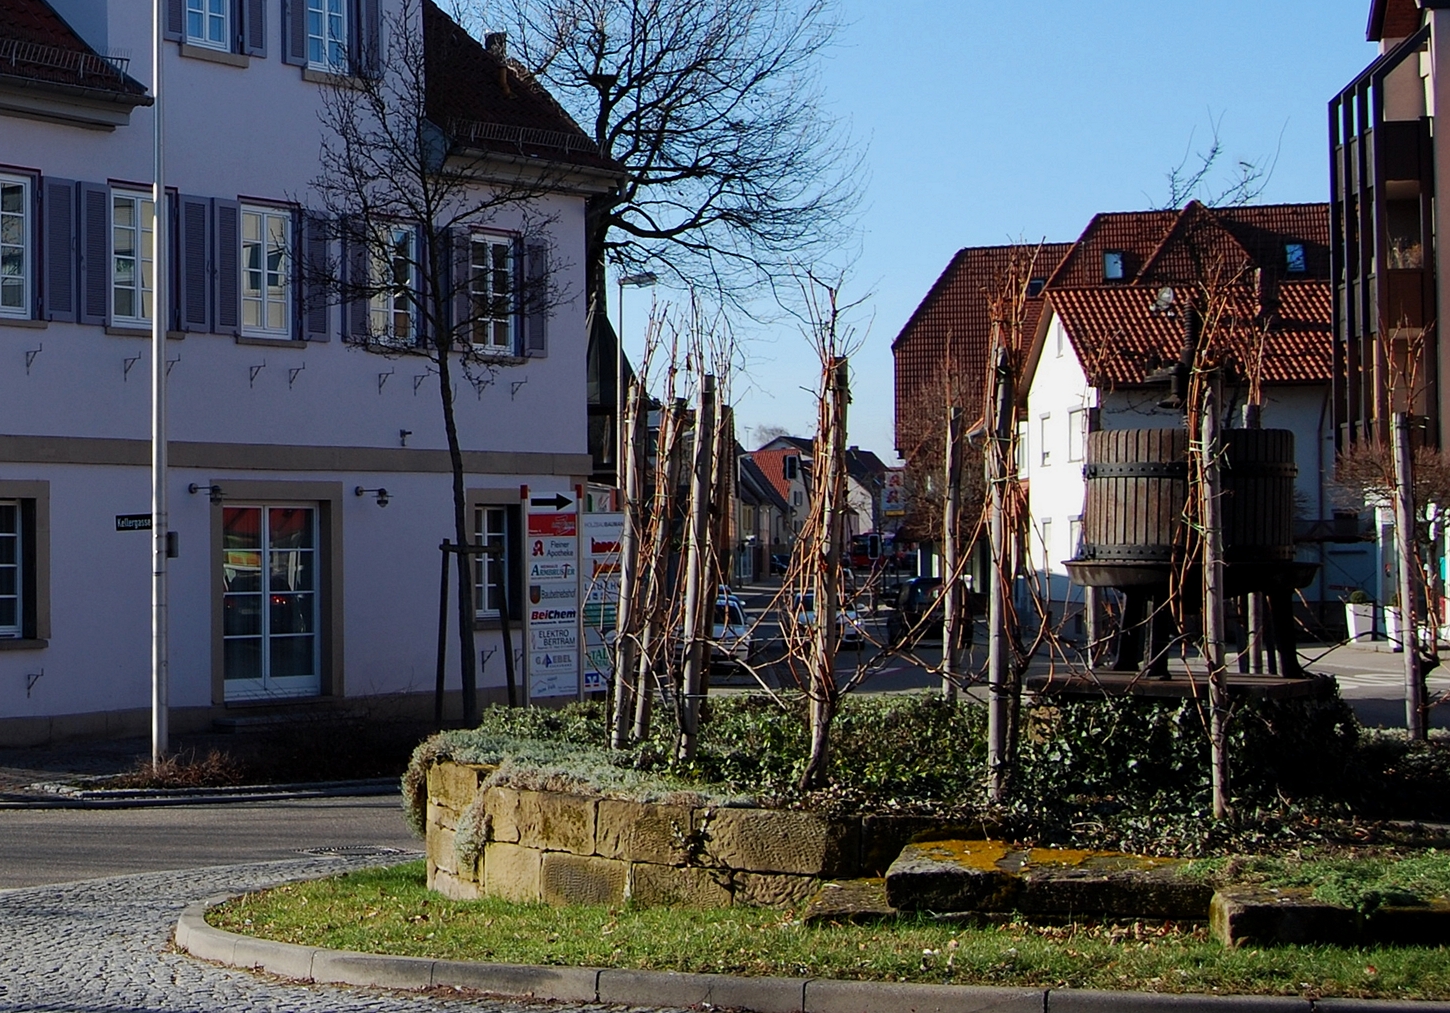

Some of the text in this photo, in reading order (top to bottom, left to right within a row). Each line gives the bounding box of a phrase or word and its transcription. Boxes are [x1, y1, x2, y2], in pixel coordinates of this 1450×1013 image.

[546, 549, 574, 559] Apotheke
[531, 609, 576, 621] BeiChem
[538, 629, 570, 639] ELEKTRO
[543, 637, 576, 646] BERTRAM
